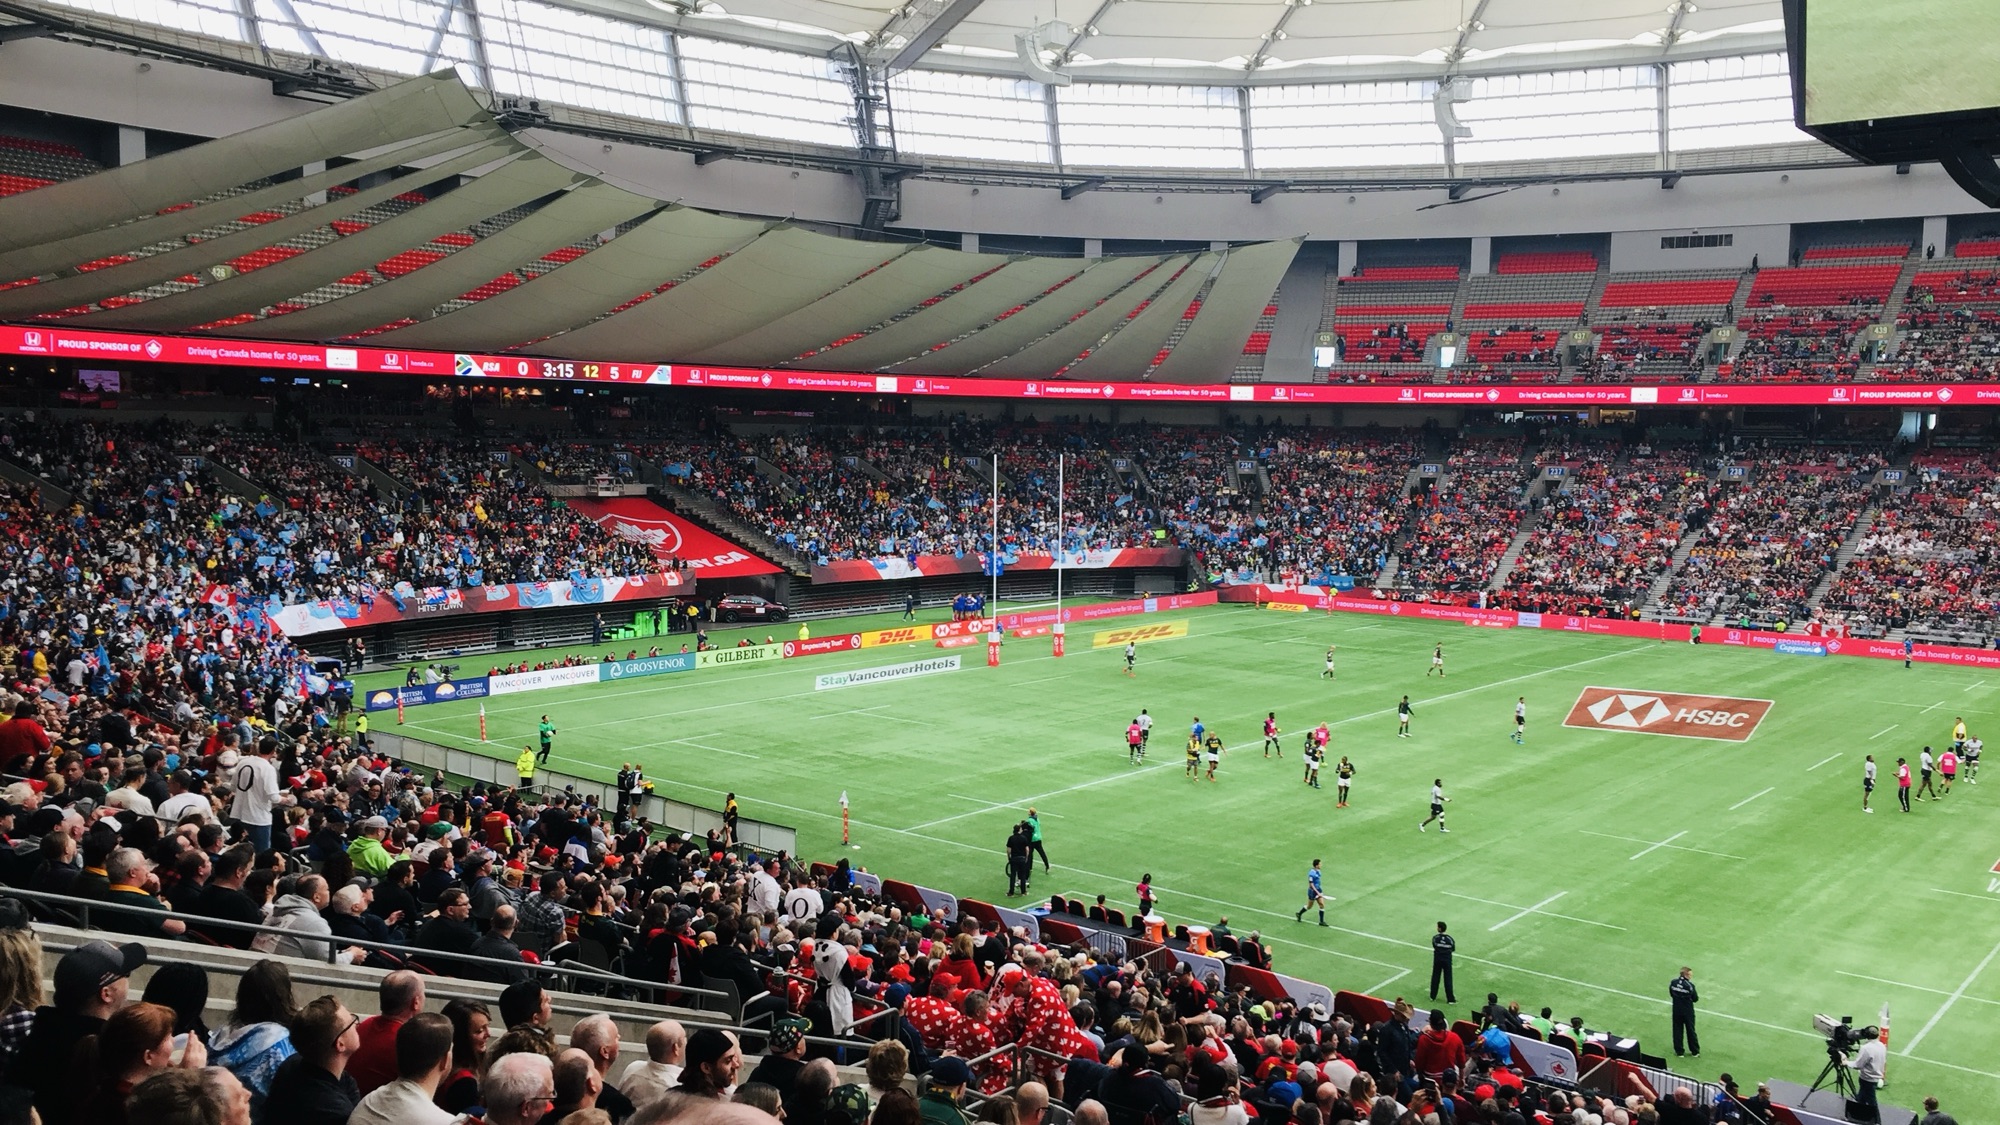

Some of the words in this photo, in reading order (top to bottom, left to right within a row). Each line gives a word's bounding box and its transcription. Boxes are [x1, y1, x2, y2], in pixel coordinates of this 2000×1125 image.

[58, 339, 88, 349] PROUD
[89, 340, 128, 351] SPONSOR
[130, 343, 141, 352] OF
[188, 346, 218, 359] Driving
[218, 348, 249, 359] Canada
[250, 349, 273, 360] home
[273, 350, 285, 361] for
[286, 351, 299, 361] 50
[299, 353, 321, 364] years.
[482, 361, 500, 372] RSA
[518, 361, 529, 376] 0
[543, 362, 574, 378] 3:15
[582, 364, 599, 378] 12
[610, 367, 619, 380] 5
[709, 374, 727, 382] PROUD
[788, 377, 807, 386] Driving
[807, 378, 826, 386] Canada
[1131, 388, 1151, 397] Driving
[1519, 392, 1541, 400] Driving
[1977, 391, 2000, 399] Drivin
[337, 458, 352, 468] 226
[418, 604, 437, 612] HITS
[439, 602, 463, 610] TOWN
[1420, 608, 1440, 616] Driving
[879, 629, 916, 644] DHL
[1107, 625, 1174, 644] DHL
[1753, 636, 1777, 644] PROUD
[801, 640, 831, 651] Empowering
[1779, 644, 1813, 653] Capgemini
[716, 648, 765, 663] GILBERT
[1870, 646, 1896, 656] Driving
[1928, 651, 1950, 659] home
[1951, 652, 1963, 660] for
[1977, 655, 2000, 663] years.
[625, 657, 686, 673] GROSVENOR
[551, 670, 595, 681] VANCOUVER
[821, 658, 956, 687] StayVancouverHotels
[495, 677, 542, 688] VANCOUVER
[456, 688, 486, 696] COLUMBIA
[394, 696, 426, 704] CLUMBIA
[1673, 708, 1750, 727] HSBC
